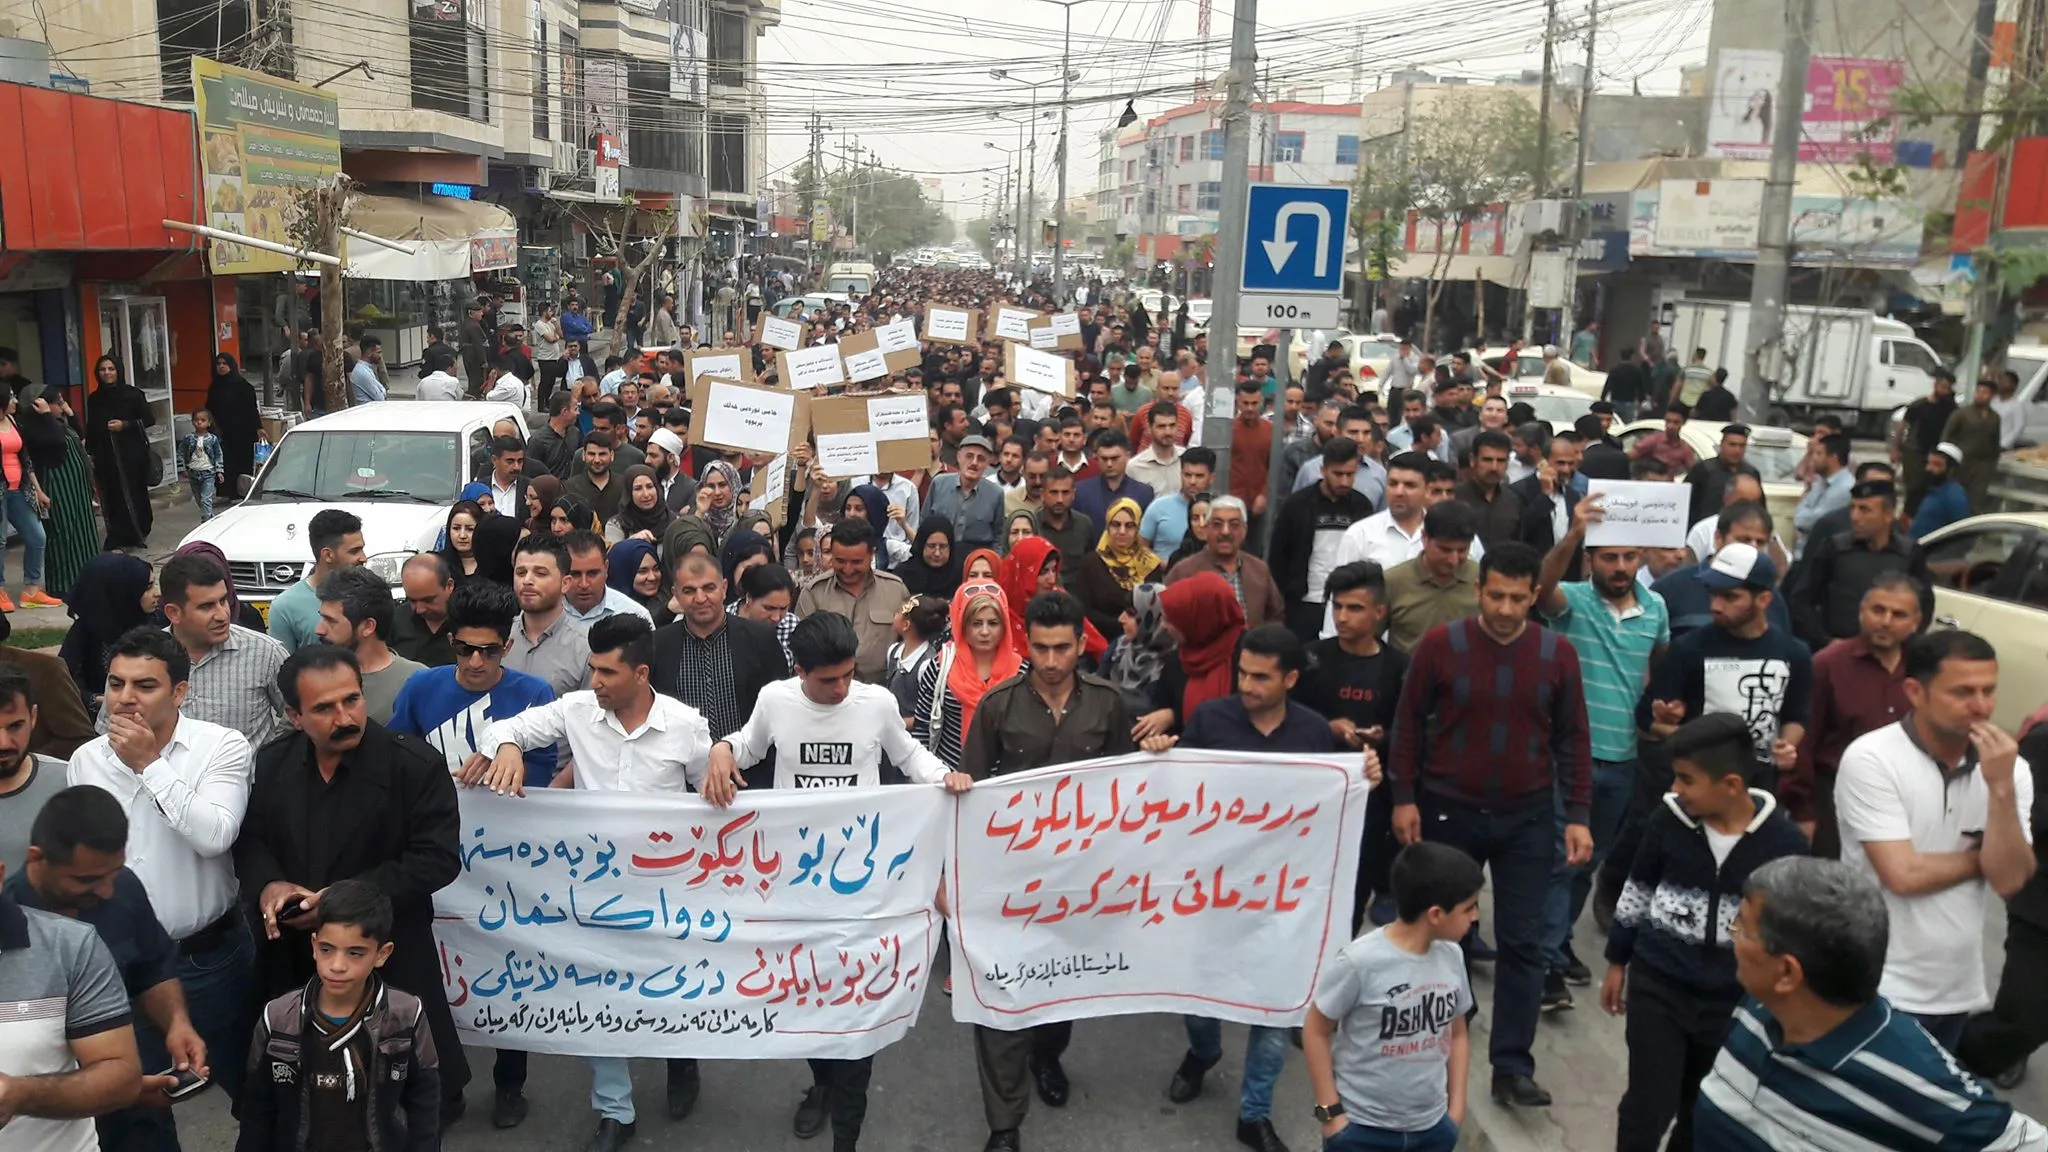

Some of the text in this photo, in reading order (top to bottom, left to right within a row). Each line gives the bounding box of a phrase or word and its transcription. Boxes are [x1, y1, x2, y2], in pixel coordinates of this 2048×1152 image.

[1266, 305, 1298, 319] 100
[804, 743, 849, 764] NEW
[797, 776, 853, 789] YORK
[583, 832, 622, 883] بۆ
[789, 826, 825, 887] بۆ
[829, 951, 865, 1006] بۆ
[1381, 1040, 1419, 1057] DENIM
